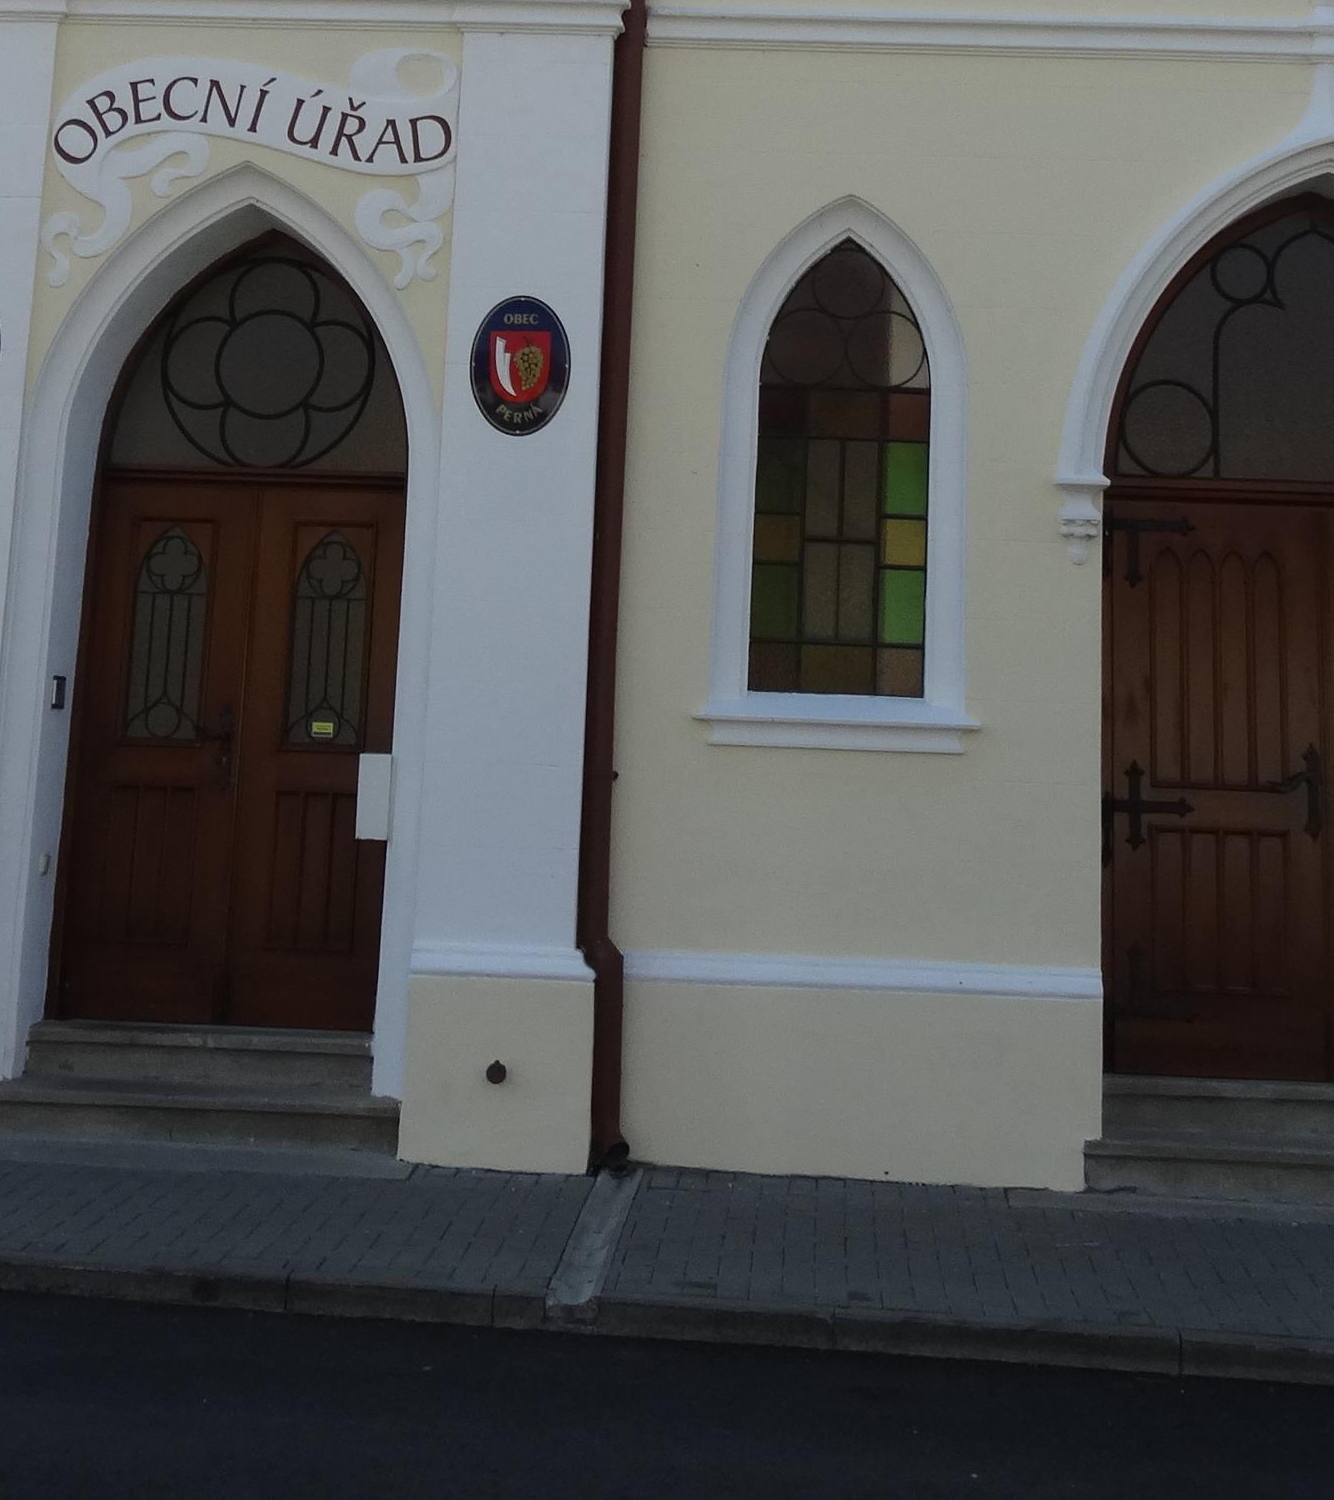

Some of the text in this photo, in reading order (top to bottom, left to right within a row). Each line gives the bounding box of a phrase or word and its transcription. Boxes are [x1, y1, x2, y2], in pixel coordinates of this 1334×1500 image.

[53, 76, 453, 165] OBECNÍ ÚŘAD
[503, 313, 540, 325] OBEC
